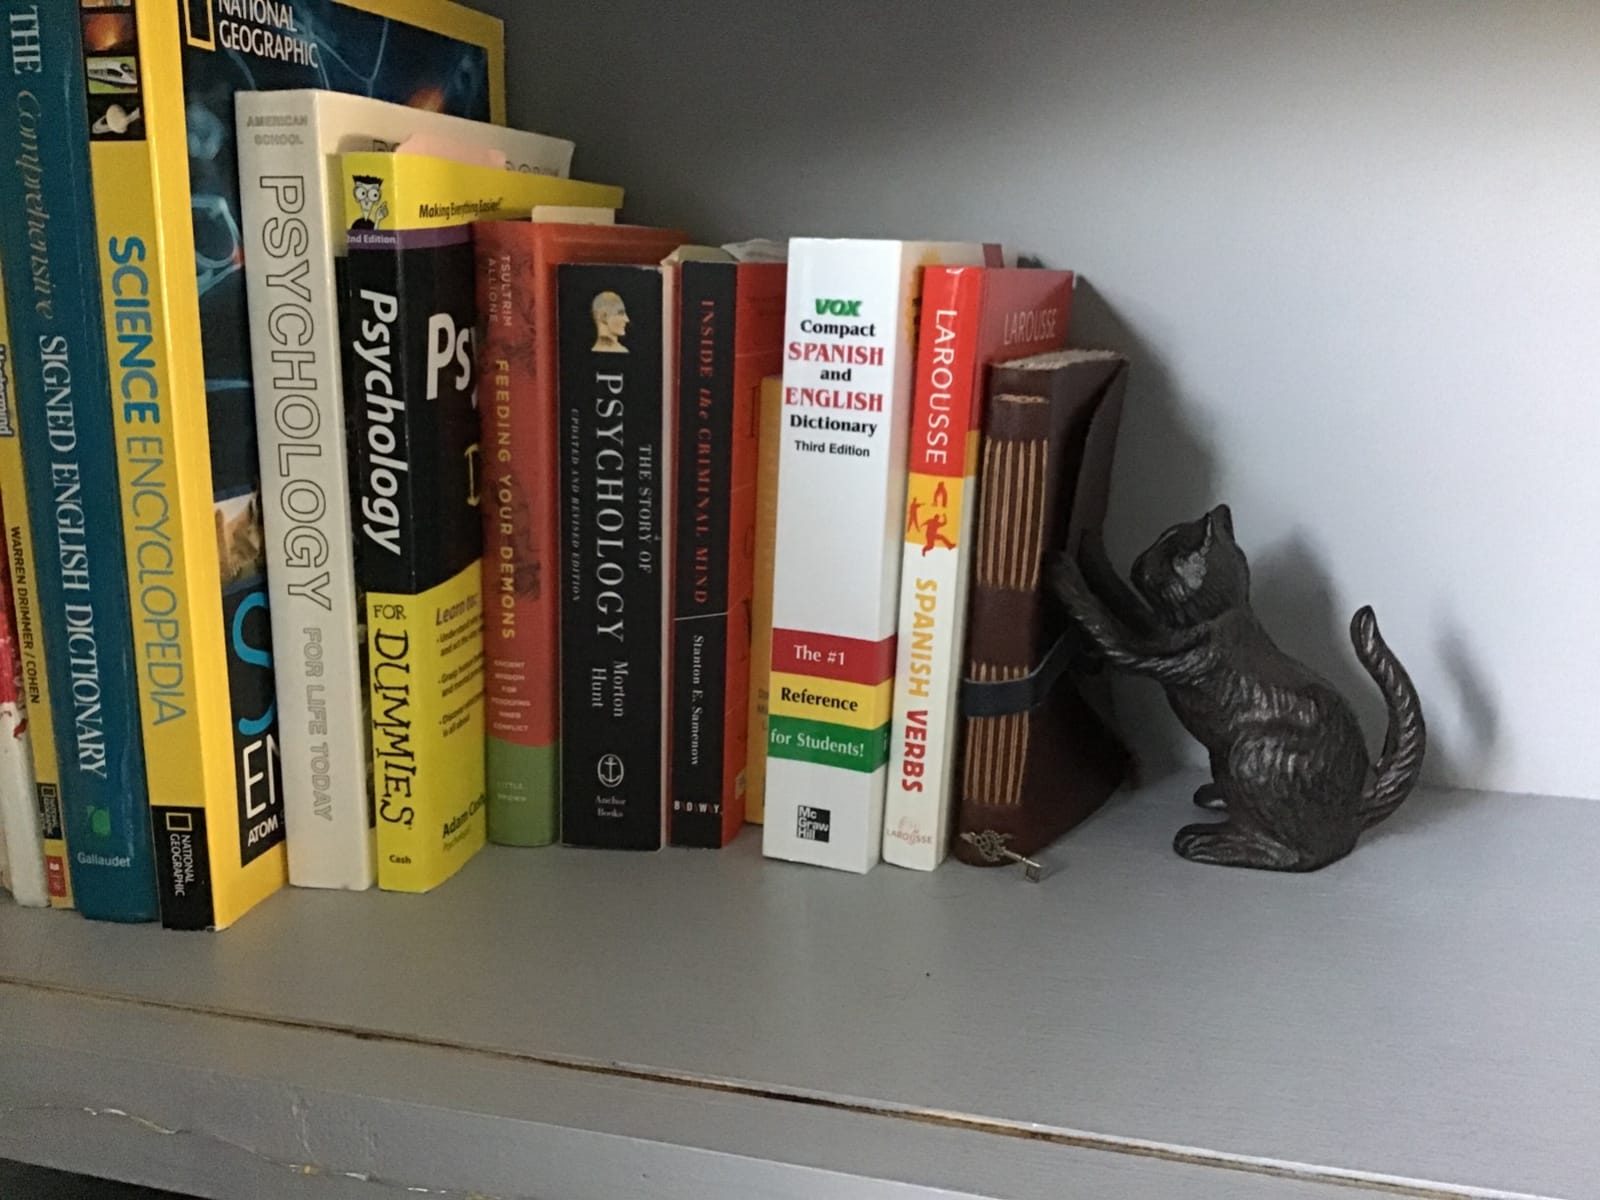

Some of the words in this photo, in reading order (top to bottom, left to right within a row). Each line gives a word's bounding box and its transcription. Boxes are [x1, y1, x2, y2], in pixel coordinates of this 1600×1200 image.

[9, 6, 42, 76] THE
[218, 0, 297, 32] NATIONAL
[219, 20, 319, 68] GEOGRAPHIC
[247, 115, 307, 127] AMERICAN
[254, 134, 303, 145] SCHOOL
[15, 89, 55, 320] Comprehensive
[419, 203, 450, 220] Making
[363, 234, 396, 243] Edition
[488, 258, 498, 322] ALLIONE
[501, 255, 513, 327] TSULTRIM
[109, 236, 160, 424] SCIENCE
[700, 301, 714, 377] INSIDE
[800, 320, 876, 338] Compact
[1004, 309, 1057, 345] LAROUSSE
[426, 313, 477, 408] Ps
[788, 341, 884, 366] SPANISH
[820, 368, 852, 382] and
[39, 335, 77, 453] SIGNED
[260, 175, 332, 611] PSYCHOLOGY
[496, 360, 511, 463] FEEDING
[699, 388, 712, 420] the
[785, 387, 883, 412] ENGLISH
[925, 309, 957, 464] LAROUSSE
[353, 289, 408, 555] Psychology
[790, 414, 877, 437] Dictionary
[638, 444, 652, 481] THE
[794, 440, 826, 453] Third
[829, 443, 870, 457] Edition
[499, 474, 513, 535] YOUR
[596, 371, 624, 643] PSYCHOLOGY
[696, 428, 712, 536] CRIMINAL
[51, 463, 89, 592] ENGLISH
[638, 487, 652, 543] STORY
[10, 526, 29, 584] WARREN
[638, 550, 651, 574] OF
[695, 547, 709, 604] MIND
[126, 437, 187, 726] ENCYCLOPEDIA
[500, 546, 515, 640] DEMONS
[17, 588, 34, 649] DRIMMER
[373, 604, 407, 620] FOR
[436, 600, 465, 626] Learn
[303, 627, 322, 676] FOR
[693, 635, 704, 685] Stanton
[794, 645, 821, 662] The
[827, 652, 845, 665] #1
[908, 578, 937, 697] SPANISH
[26, 660, 41, 705] COHEN
[65, 603, 107, 779] DICTIONARY
[592, 668, 607, 707] Hunt
[613, 661, 629, 717] Morton
[781, 687, 858, 711] Reference
[306, 683, 325, 735] LIFE
[373, 627, 416, 826] DUMMIES
[692, 706, 703, 765] Samenow
[771, 728, 791, 745] for
[796, 732, 864, 757] Students!
[901, 709, 928, 792] VERBS
[310, 741, 332, 821] TODAY
[247, 815, 278, 849] ATOM
[442, 810, 468, 839] Adam
[797, 829, 816, 840] Hill
[798, 817, 829, 832] Graw
[799, 806, 817, 820] Mc
[886, 829, 933, 845] LAROUSSE
[77, 851, 131, 868] Gallaudet
[170, 834, 185, 897] GEOGRAPHIC
[181, 834, 195, 884] NATIONAL
[389, 854, 411, 865] Cash
